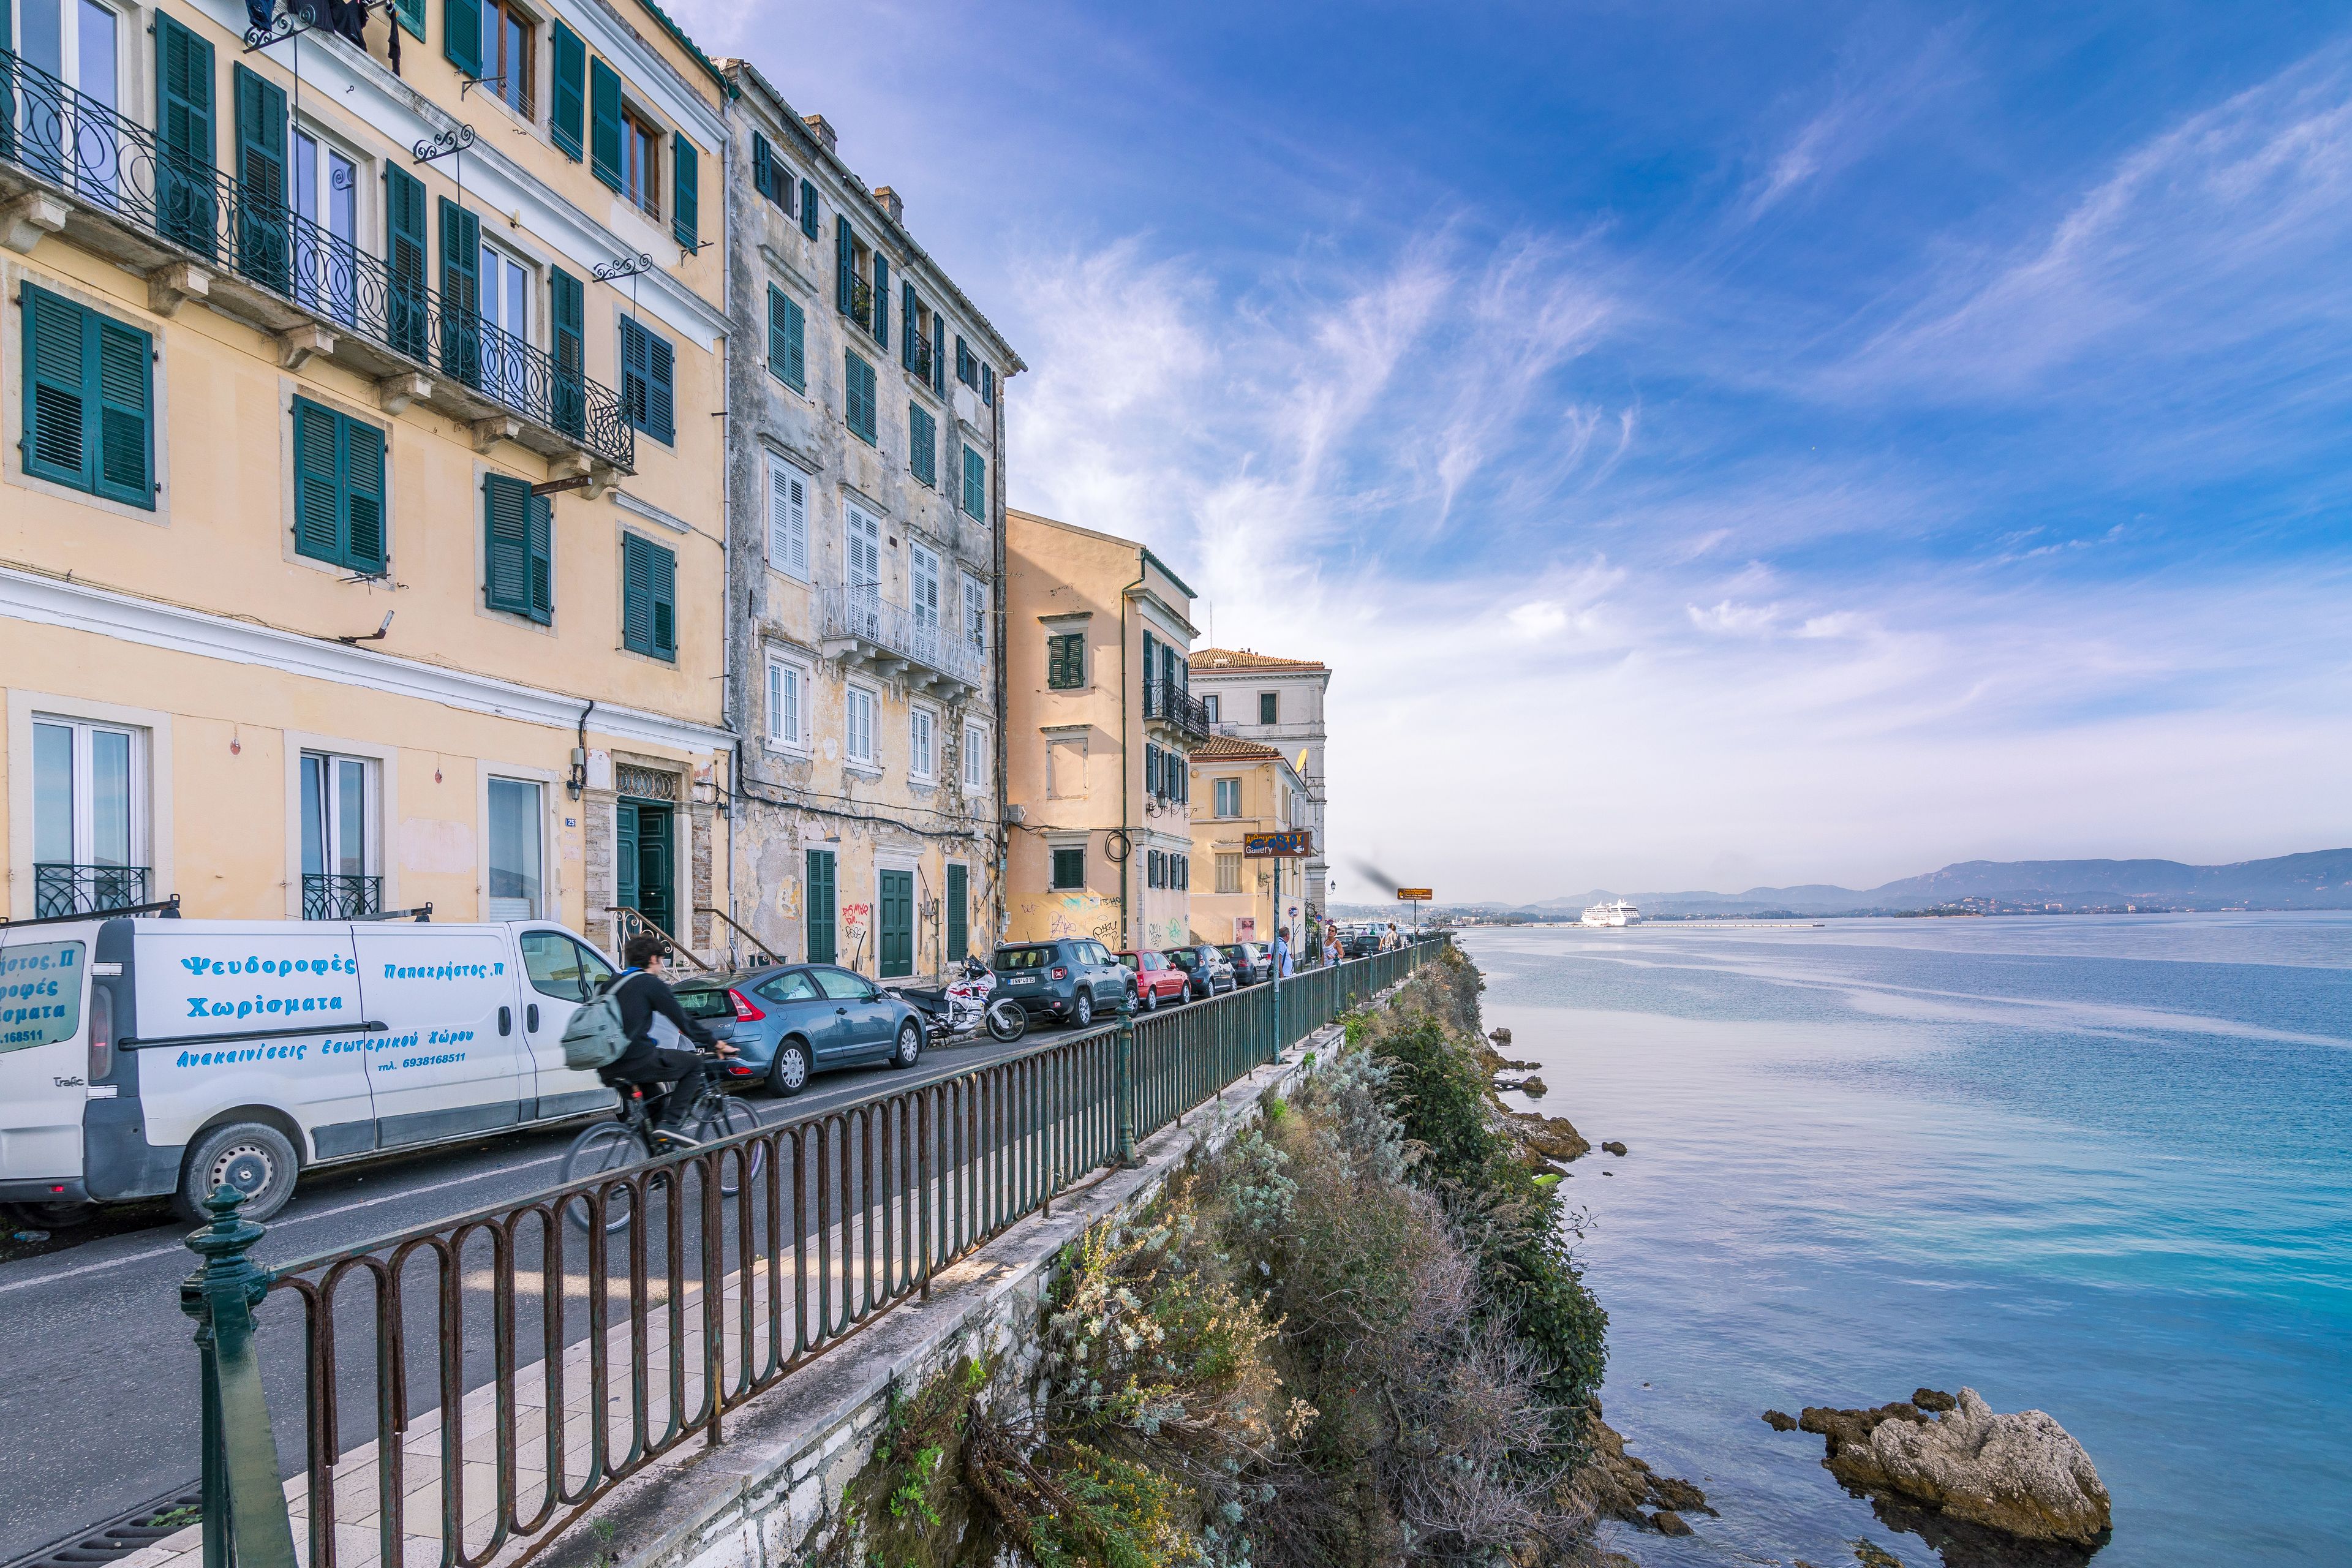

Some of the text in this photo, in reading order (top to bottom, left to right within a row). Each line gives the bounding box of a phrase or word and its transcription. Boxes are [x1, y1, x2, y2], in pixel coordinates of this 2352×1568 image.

[1246, 846, 1273, 854] Gallery
[0, 1005, 66, 1025] σματα
[187, 995, 342, 1019] Χωρίσματα
[176, 1029, 474, 1068] Ανακαινίσεις Εσωτερικού Χώρου
[378, 1052, 466, 1071] τηλ. 6938168511
[53, 1076, 85, 1087] Trafic
